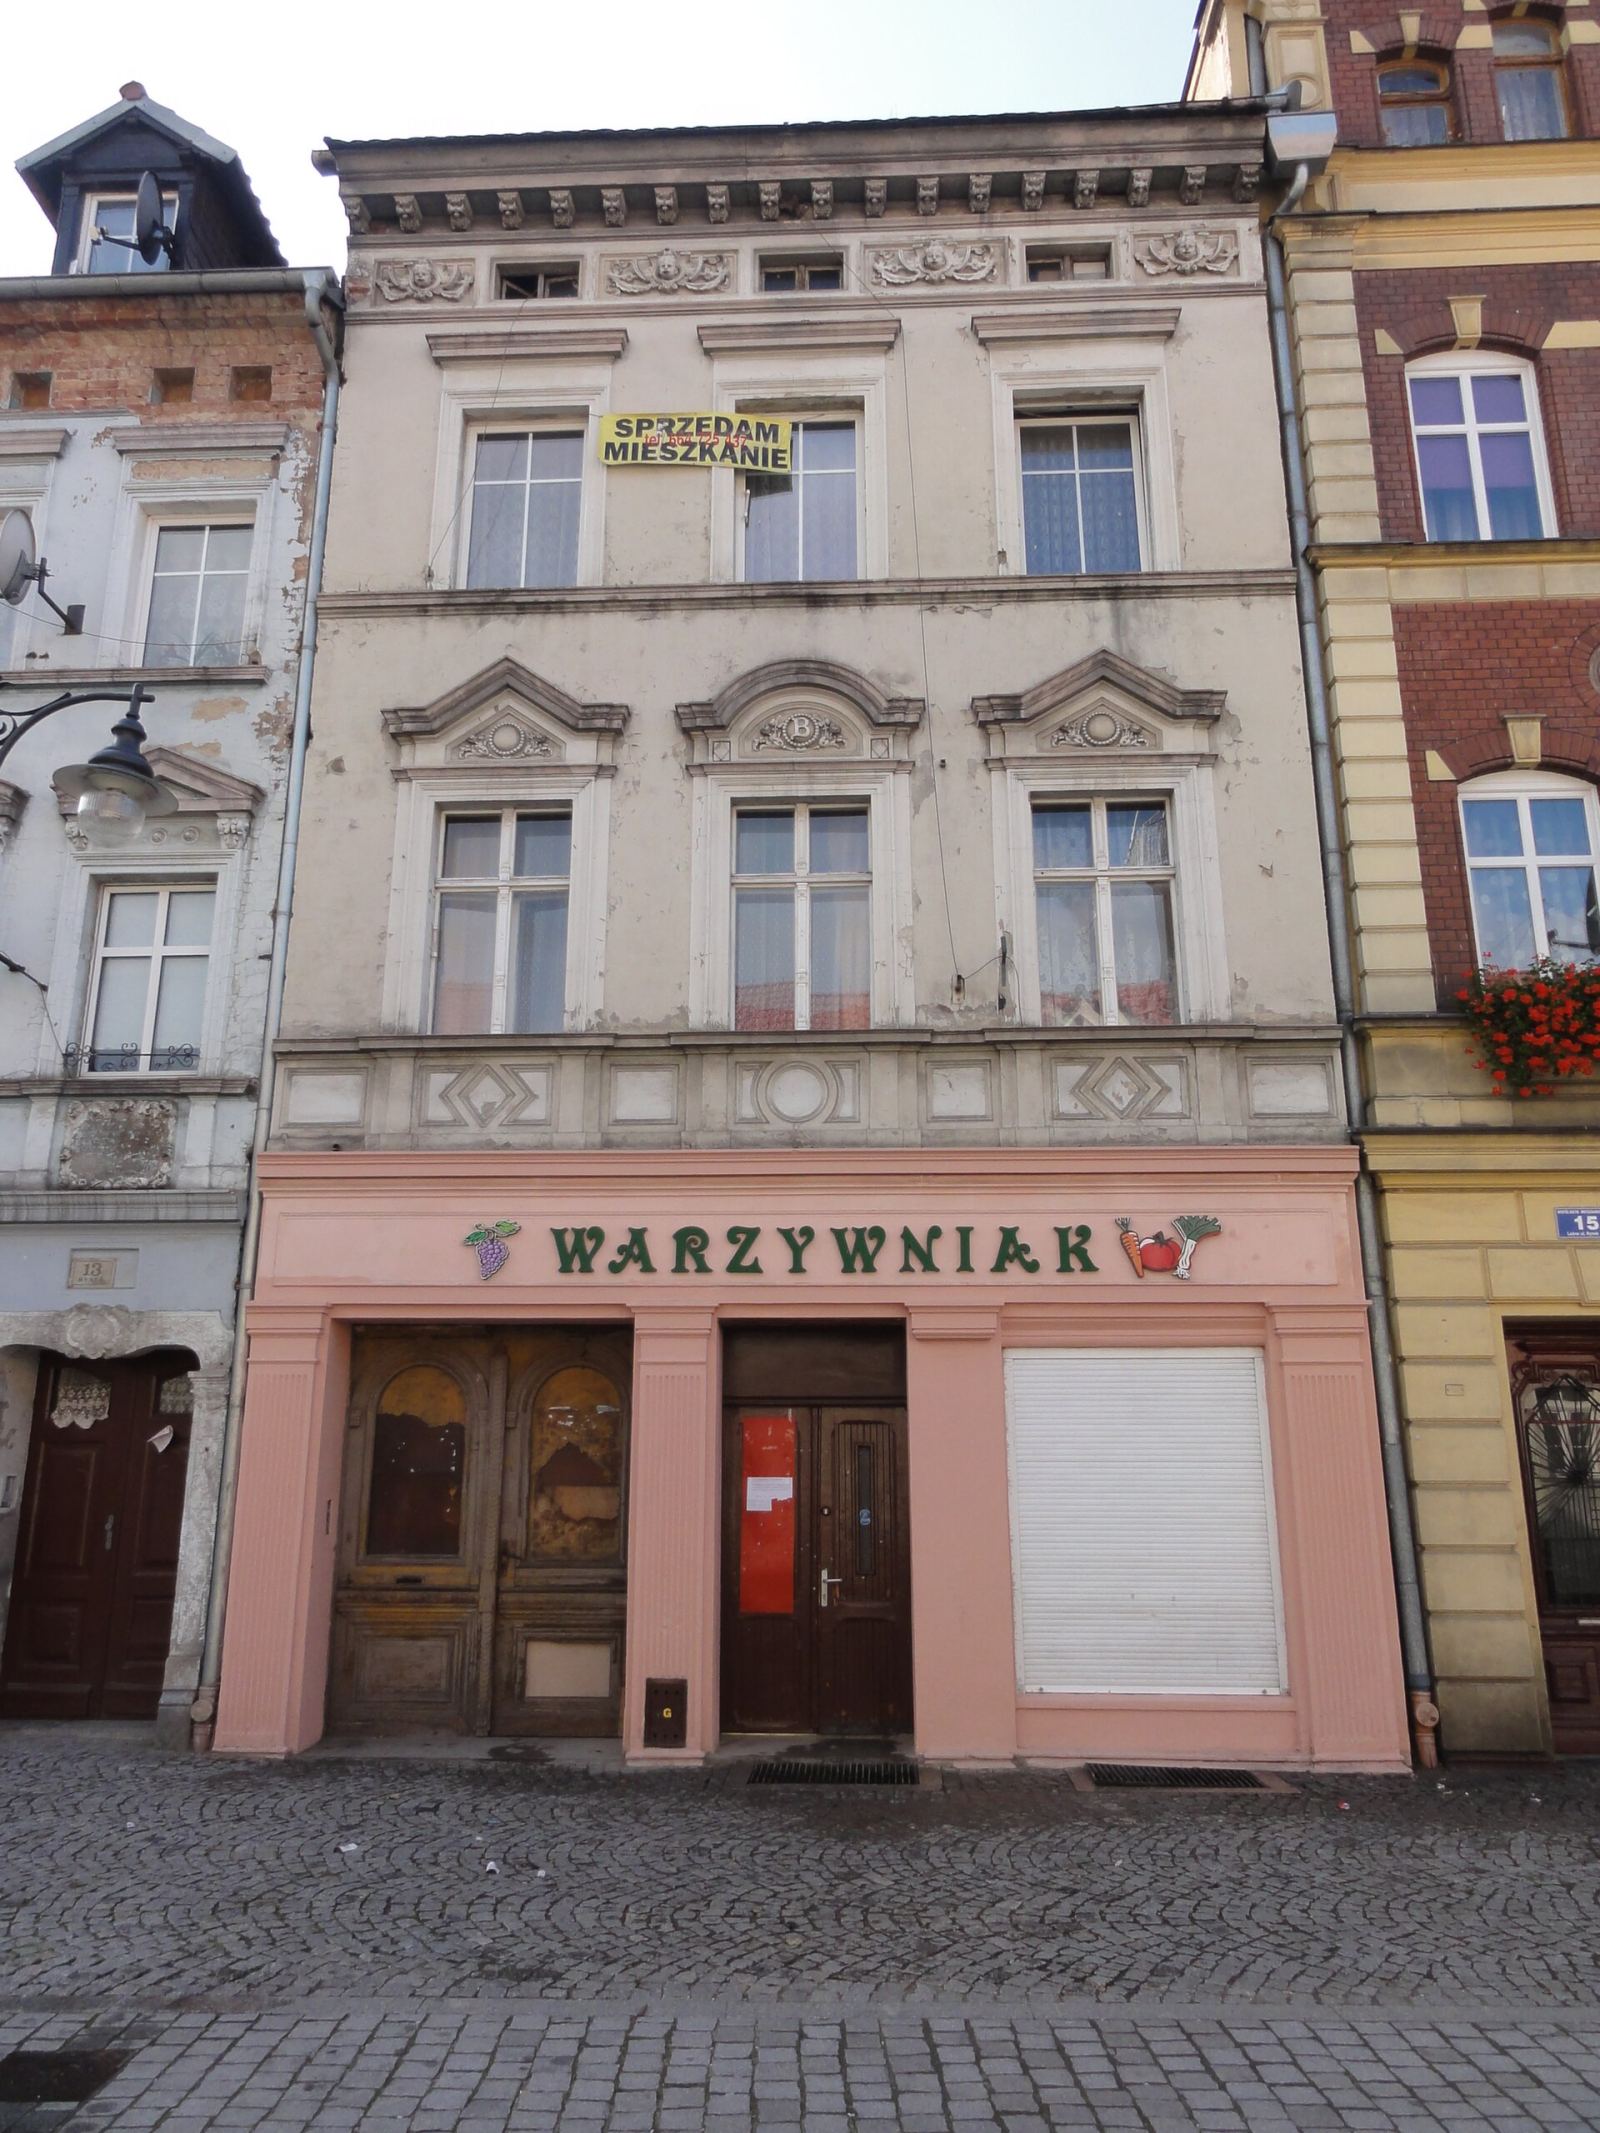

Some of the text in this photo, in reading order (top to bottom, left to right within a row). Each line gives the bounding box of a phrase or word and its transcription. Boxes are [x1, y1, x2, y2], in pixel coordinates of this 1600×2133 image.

[614, 416, 780, 444] SPRZEDAM
[604, 441, 789, 469] MIESZKANIE
[791, 716, 811, 741] B
[1573, 1215, 1600, 1231] 15
[550, 1224, 1100, 1274] WARZYWNIAK
[82, 1262, 103, 1277] 13
[662, 1707, 673, 1719] G
